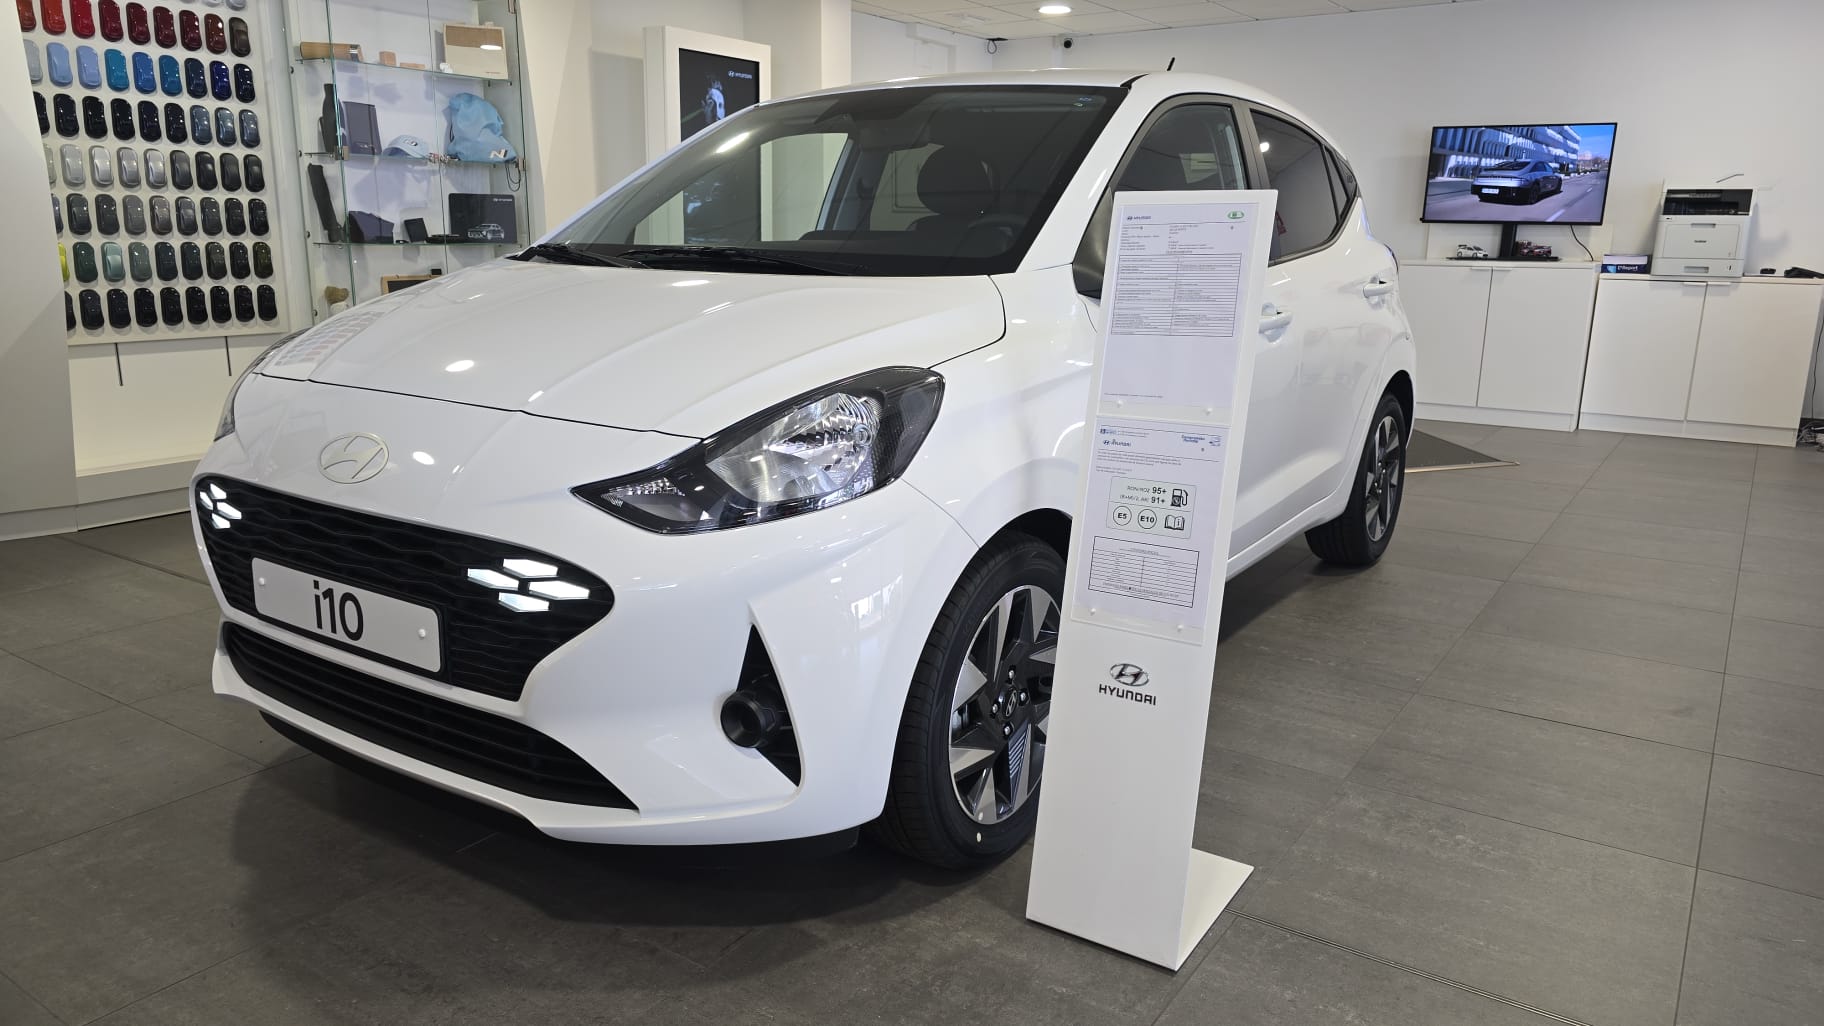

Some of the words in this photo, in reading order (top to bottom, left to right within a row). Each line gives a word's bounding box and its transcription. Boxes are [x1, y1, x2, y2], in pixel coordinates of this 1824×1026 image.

[1151, 486, 1168, 495] 95+
[1150, 496, 1166, 504] 91+
[1117, 512, 1128, 520] E5
[1140, 515, 1155, 523] E10
[313, 579, 364, 641] i10
[1098, 683, 1157, 706] HYUNDAI
